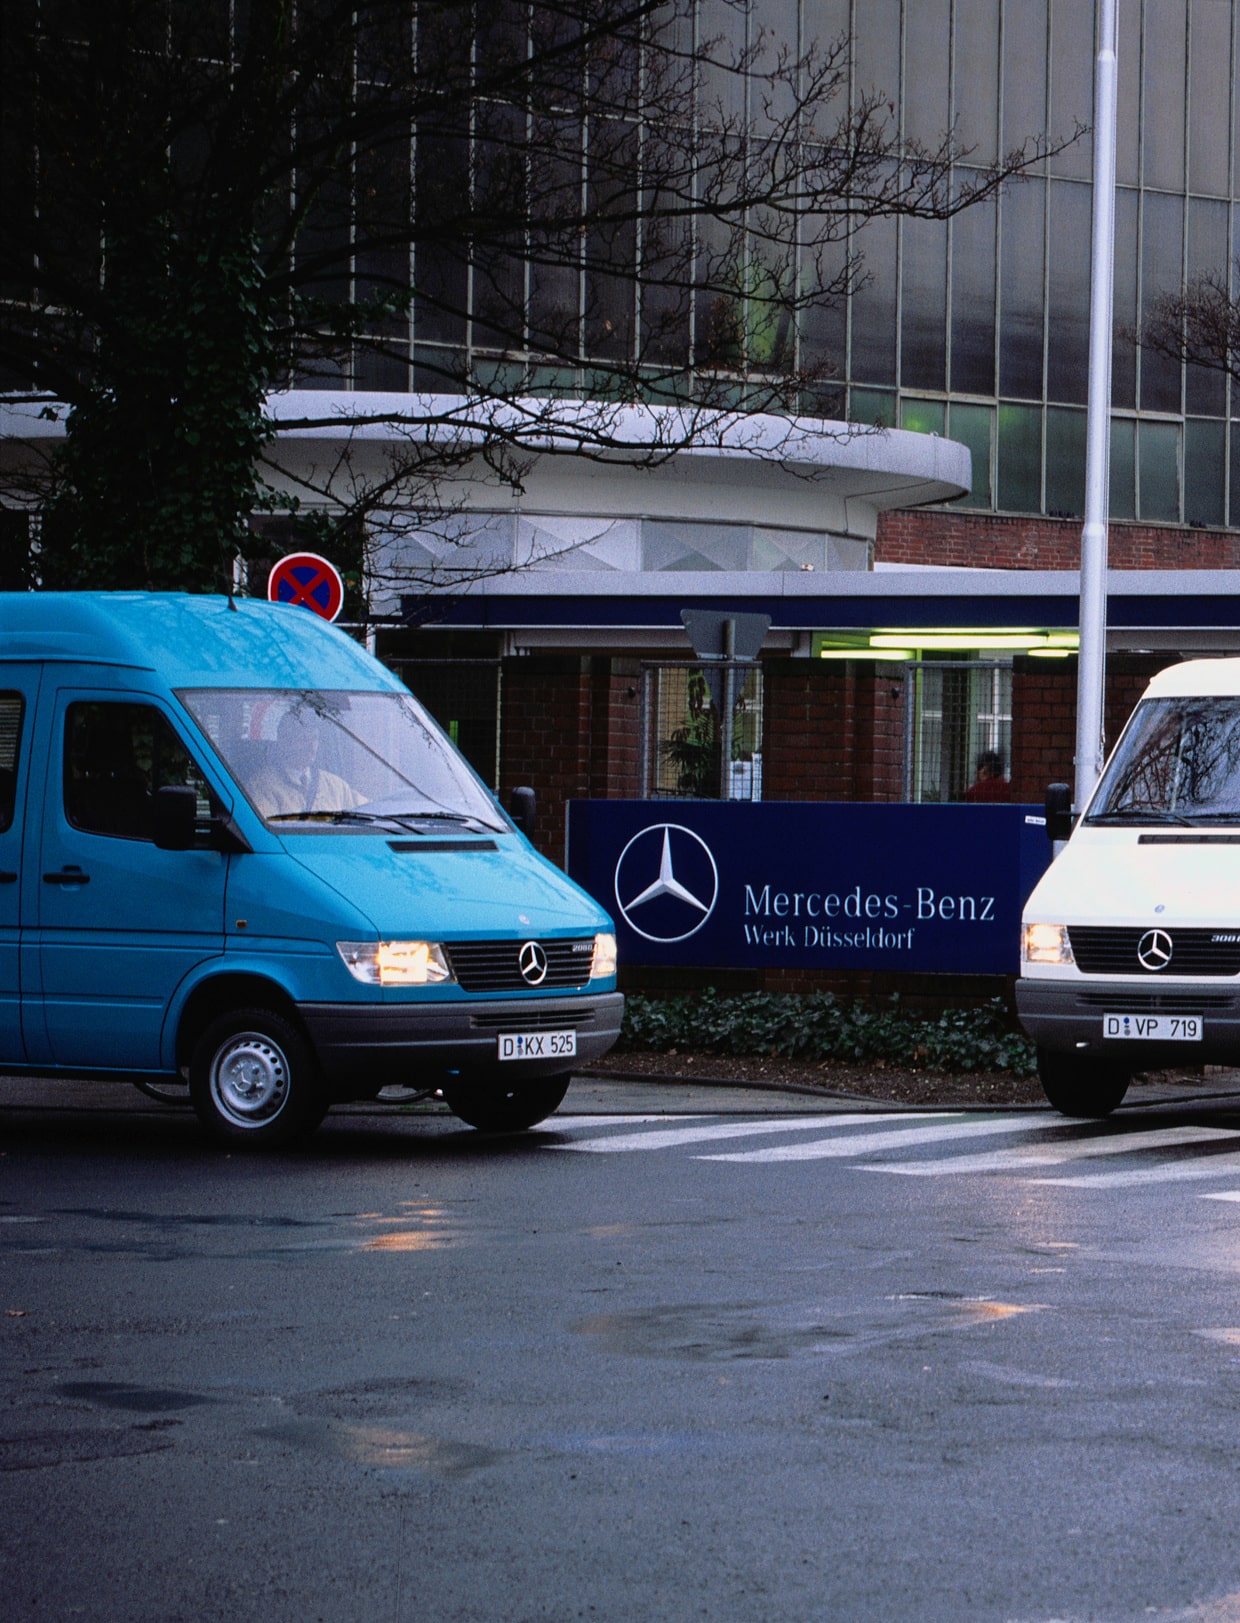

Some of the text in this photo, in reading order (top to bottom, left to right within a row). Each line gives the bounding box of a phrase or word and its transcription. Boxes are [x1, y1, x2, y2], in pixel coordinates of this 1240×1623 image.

[743, 884, 995, 921] Mercedes-Benz
[743, 923, 916, 950] Werk Düsseldorf
[1170, 1019, 1197, 1037] 719
[551, 1034, 574, 1054] 525
